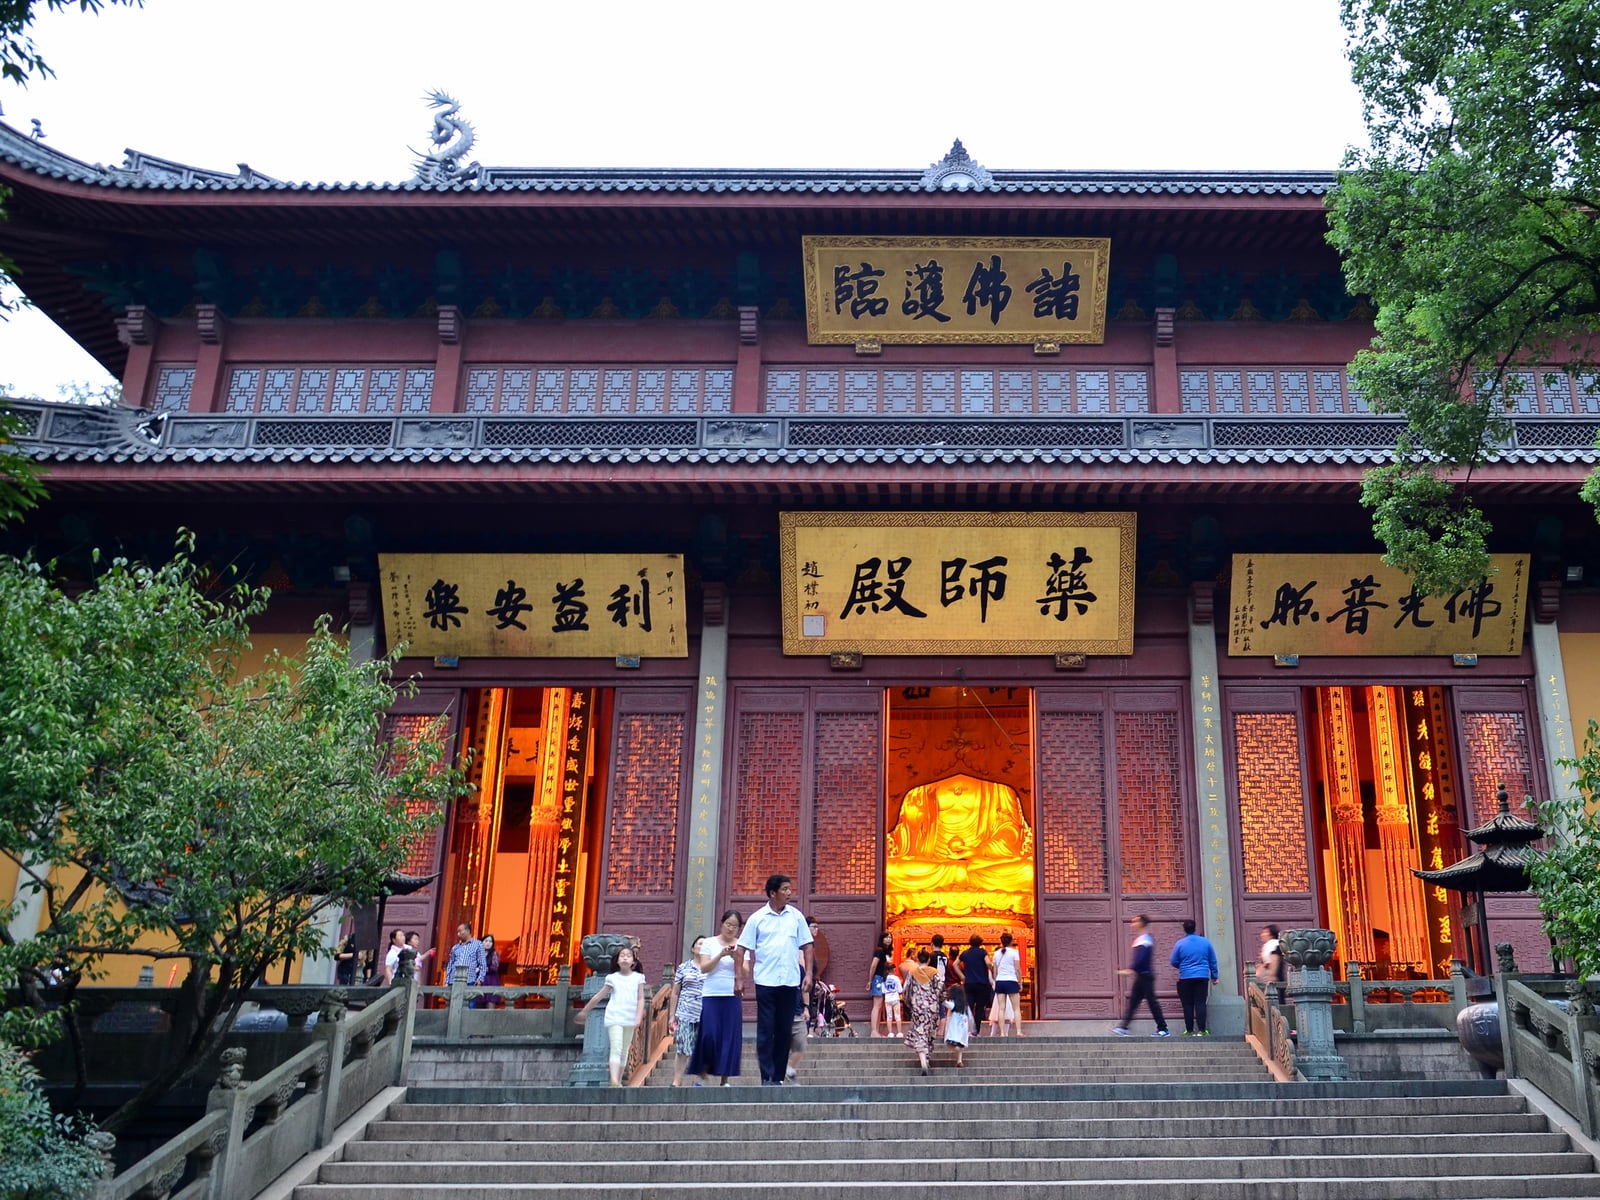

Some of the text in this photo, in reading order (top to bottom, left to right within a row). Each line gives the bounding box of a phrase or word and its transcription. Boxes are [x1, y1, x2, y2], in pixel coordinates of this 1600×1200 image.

[422, 578, 652, 632] 利益安樂
[839, 546, 1098, 623] 藥師殿
